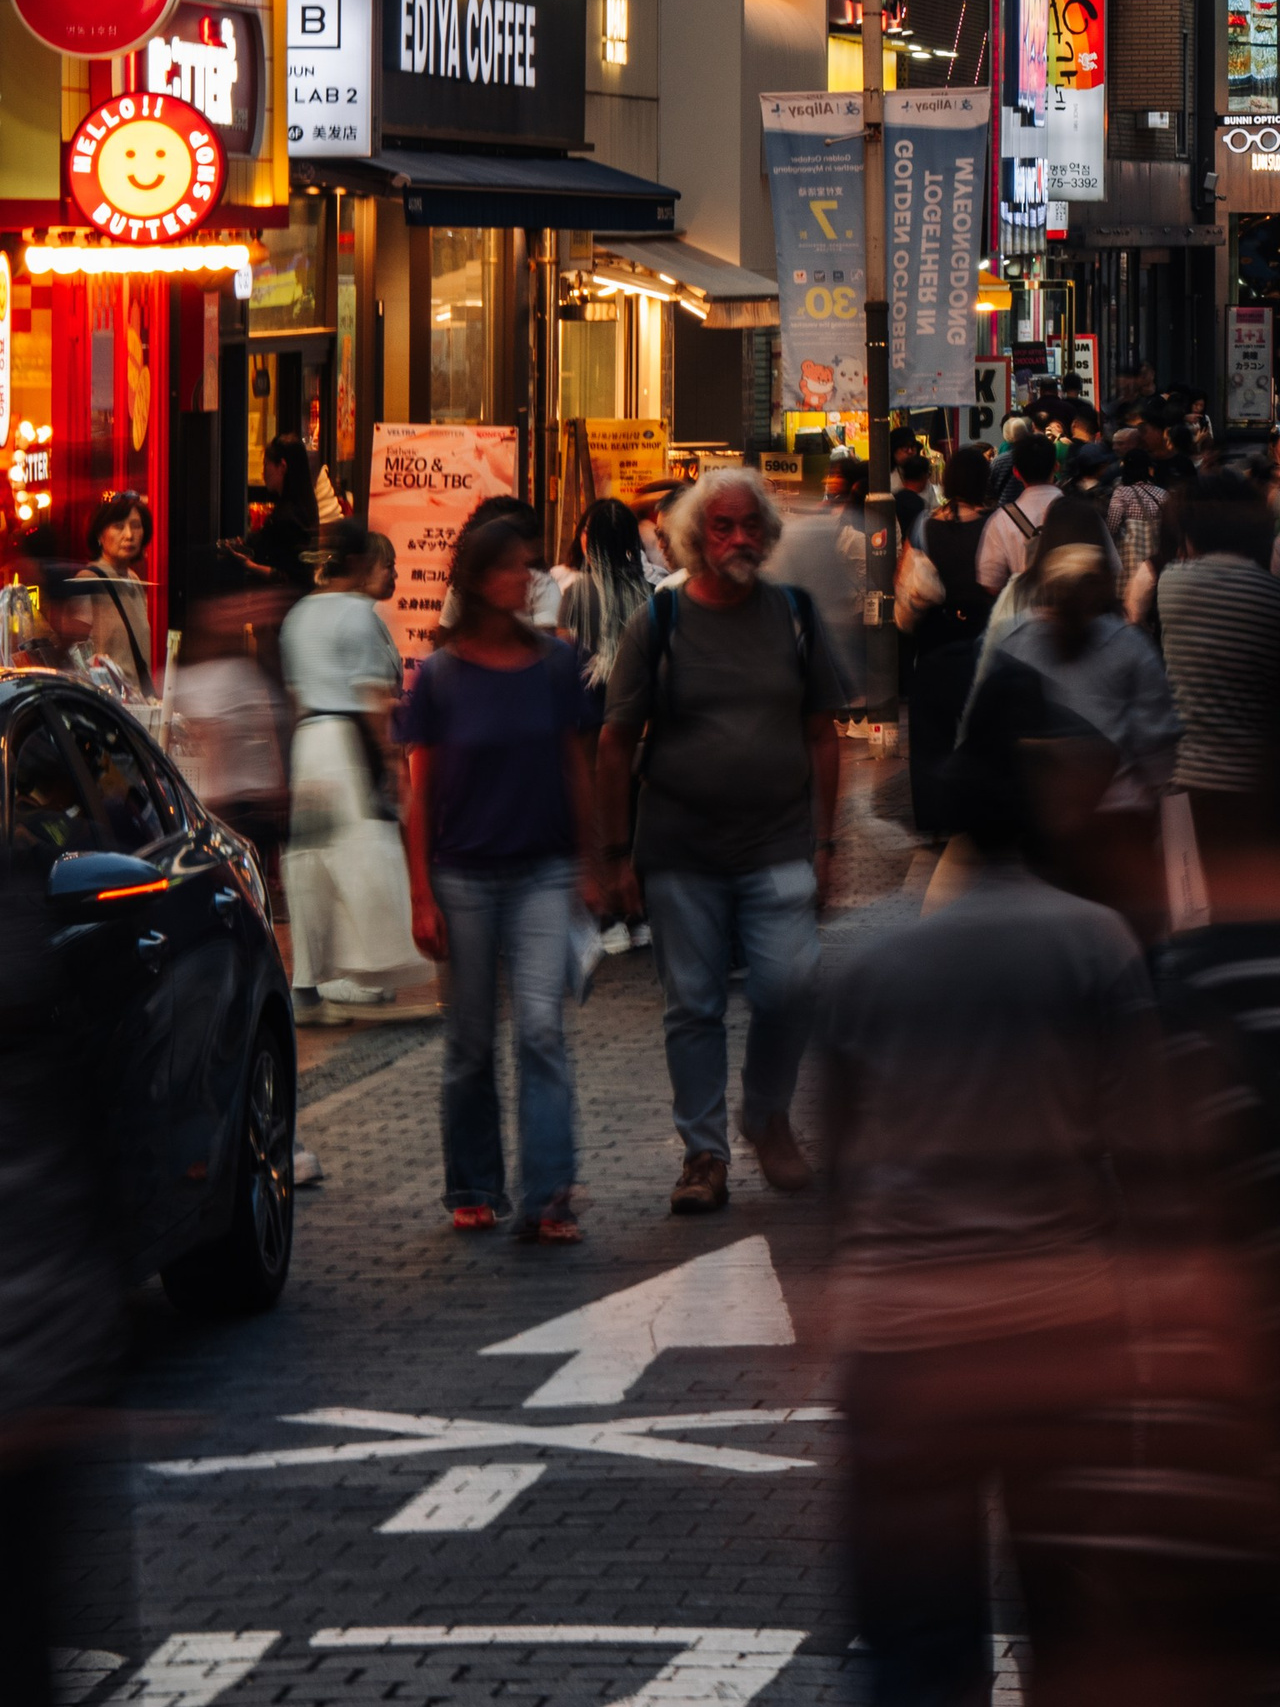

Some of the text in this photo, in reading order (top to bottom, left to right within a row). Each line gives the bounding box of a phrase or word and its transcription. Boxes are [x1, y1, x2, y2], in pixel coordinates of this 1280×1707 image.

[294, 88, 358, 104] LAB 2
[1224, 116, 1253, 126] BUNNI
[312, 125, 357, 141] 美发店
[92, 130, 218, 240] BUTTER SHOP
[1234, 328, 1266, 344] 1+1
[1235, 362, 1265, 371] カラコン
[590, 442, 662, 451] OTAL BEAUTY SHOP
[385, 457, 443, 472] MIZO &
[383, 473, 473, 489] SEOUL TBC
[423, 527, 456, 539] エステ
